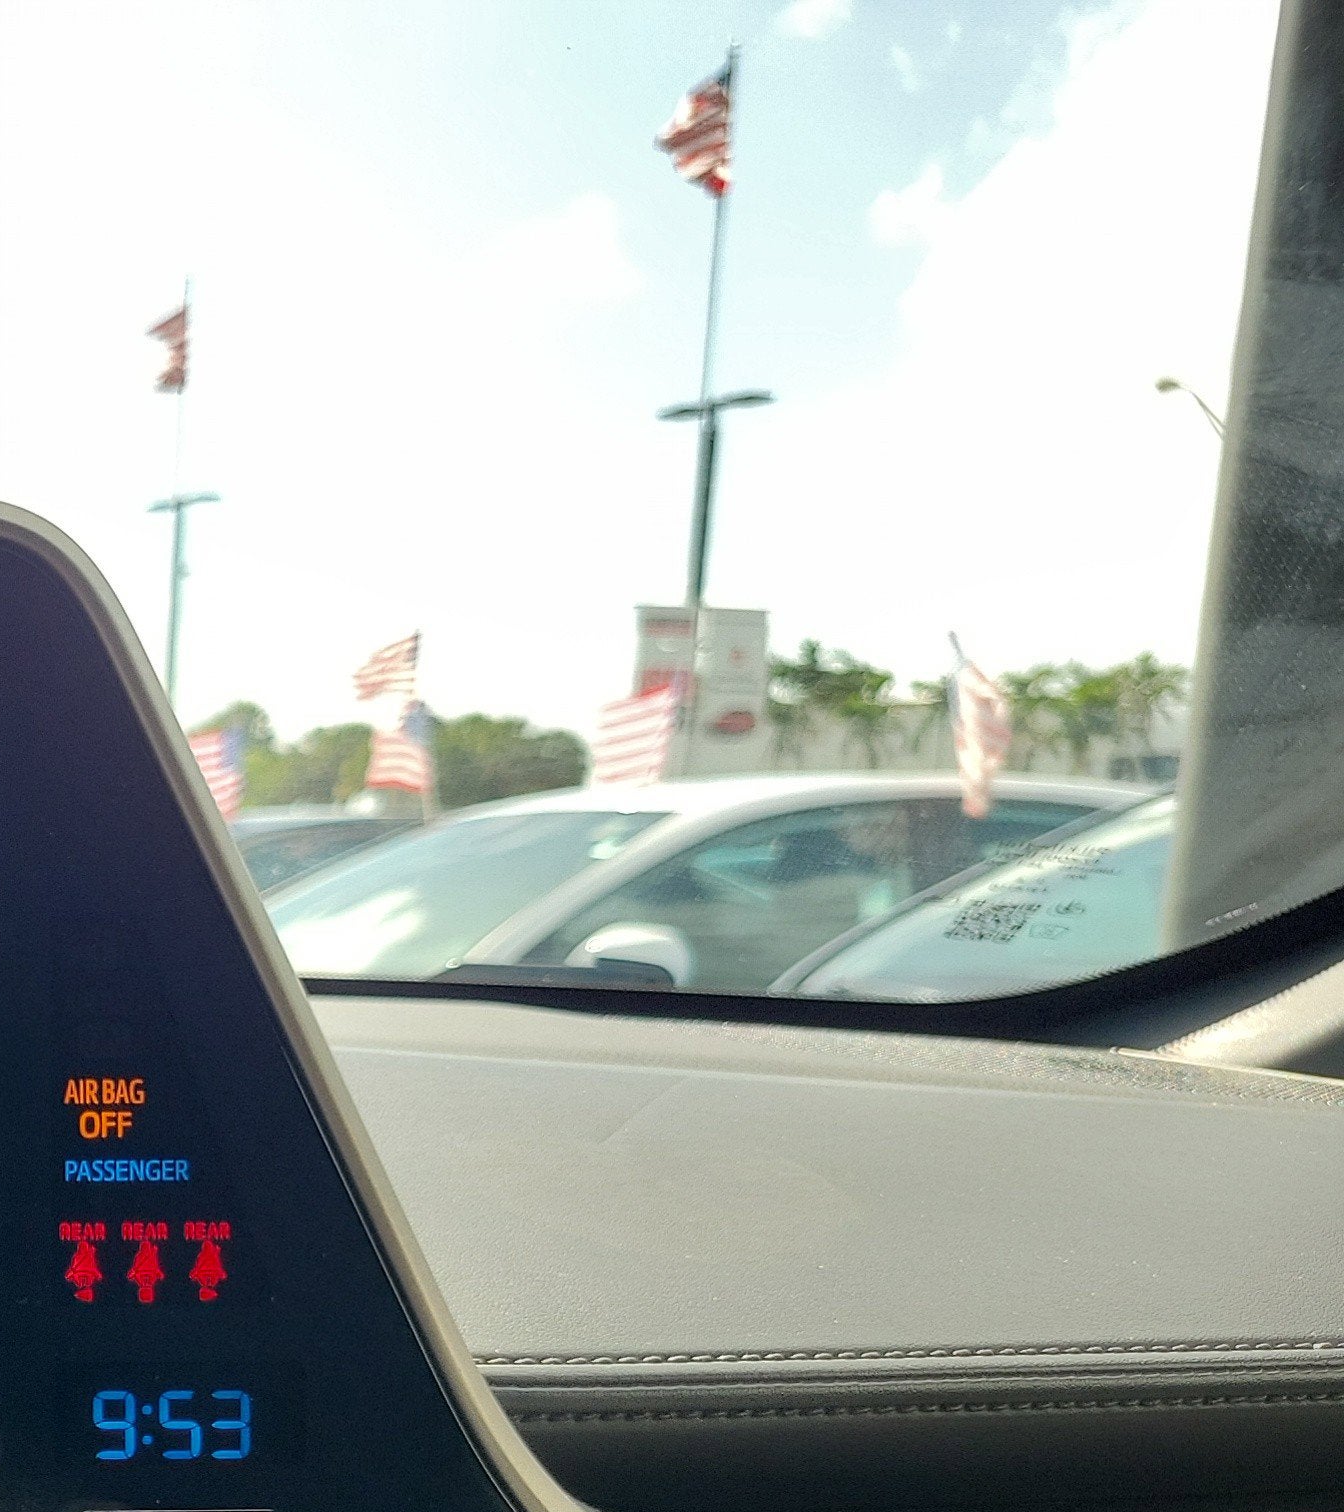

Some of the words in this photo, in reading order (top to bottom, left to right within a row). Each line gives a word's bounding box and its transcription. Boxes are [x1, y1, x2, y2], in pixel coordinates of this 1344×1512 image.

[64, 1079, 100, 1105] AIR
[101, 1079, 146, 1105] BAG
[79, 1110, 133, 1139] OFF
[64, 1159, 190, 1182] PASSENGER
[59, 1221, 107, 1241] REAR
[121, 1221, 169, 1241] REAR
[184, 1221, 231, 1241] REAR
[92, 1389, 253, 1461] 9:53
